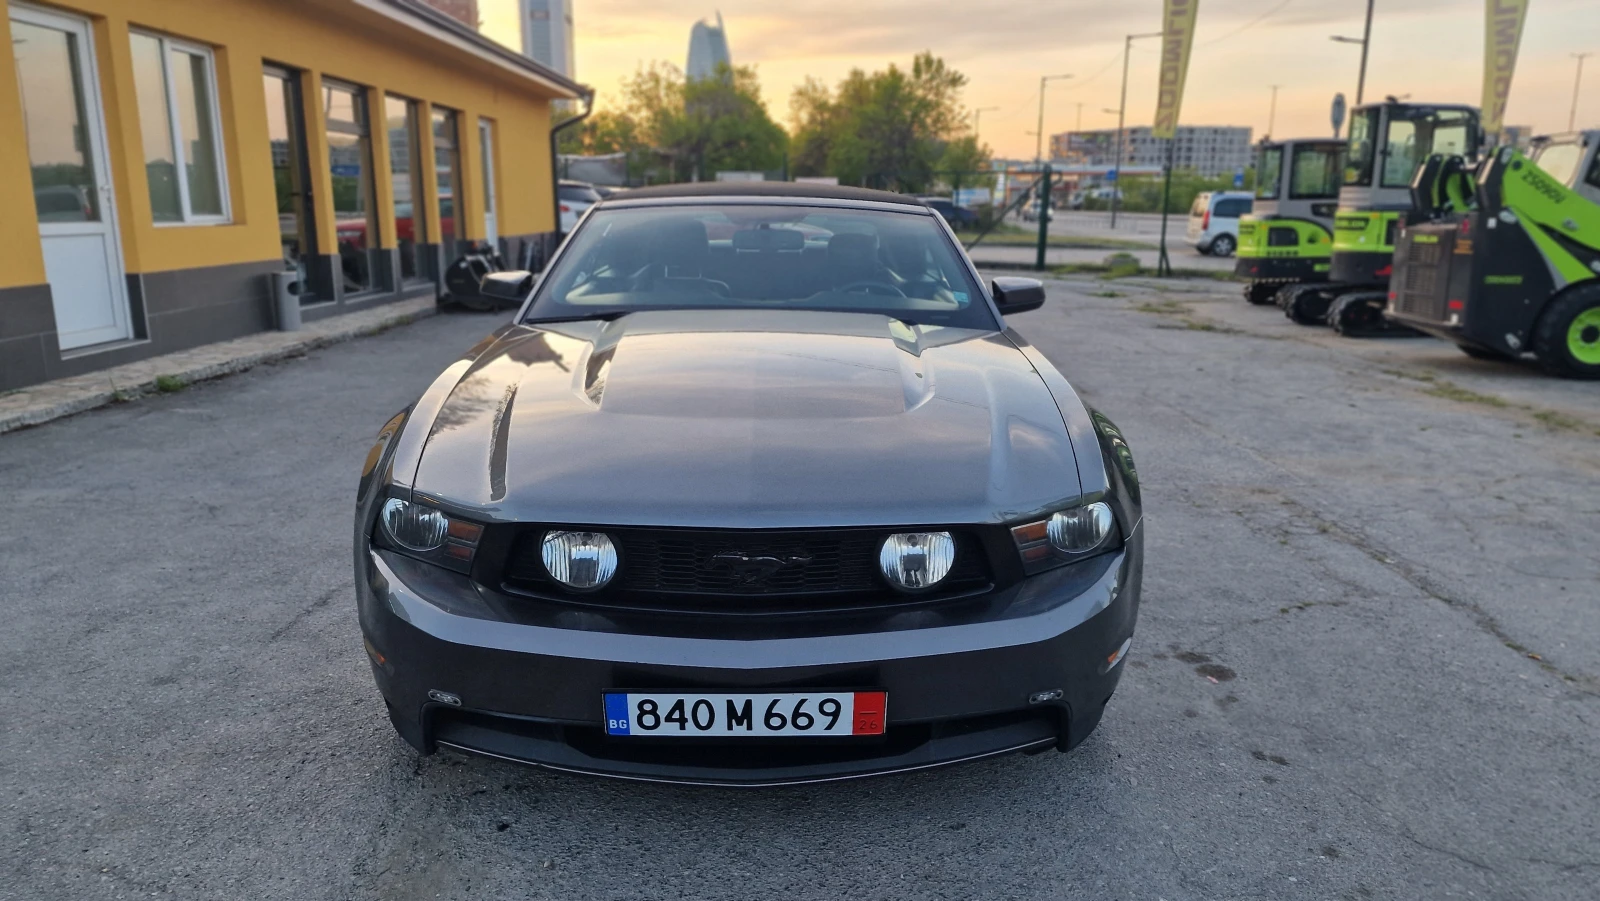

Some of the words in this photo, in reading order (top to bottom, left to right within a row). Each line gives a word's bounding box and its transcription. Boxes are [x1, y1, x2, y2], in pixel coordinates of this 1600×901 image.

[636, 698, 716, 731] 840
[726, 698, 753, 731] M
[763, 698, 842, 731] 669
[609, 719, 627, 729] BG
[859, 719, 879, 730] 26
